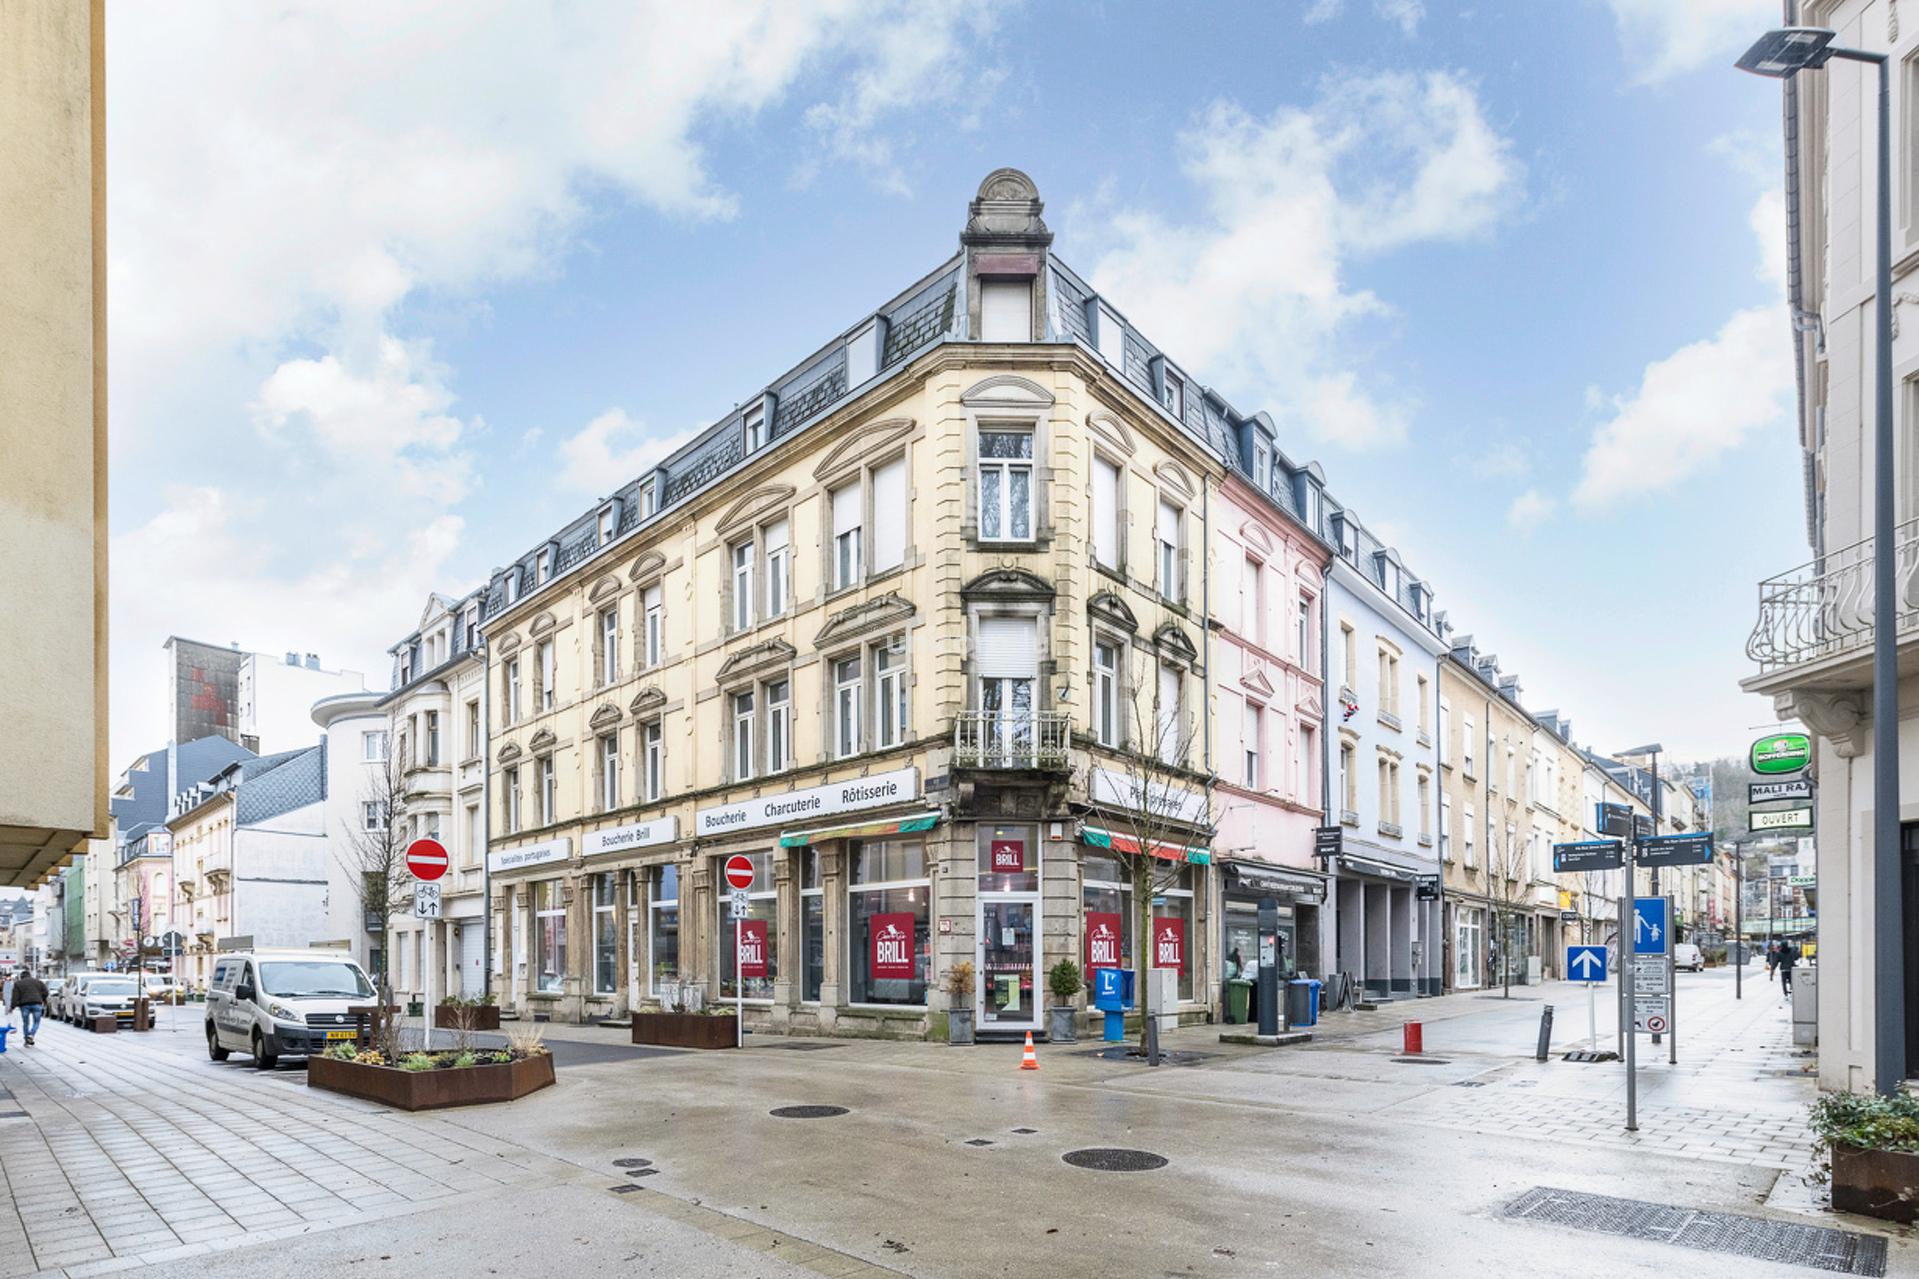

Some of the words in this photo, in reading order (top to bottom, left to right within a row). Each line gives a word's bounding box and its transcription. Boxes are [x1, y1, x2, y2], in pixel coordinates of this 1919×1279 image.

[1752, 785, 1783, 796] MALI
[705, 809, 747, 828] Boucherie
[764, 794, 821, 818] Charcuterie
[842, 780, 897, 803] Rôtisserie
[1762, 813, 1799, 825] OUVERT
[602, 830, 634, 847] Boucherie
[636, 827, 650, 841] Brill
[995, 853, 1020, 866] BRILL
[740, 941, 764, 965] BRILL
[877, 941, 909, 963] BRILL
[1091, 940, 1117, 963] BRILL
[1158, 942, 1181, 963] BRILL
